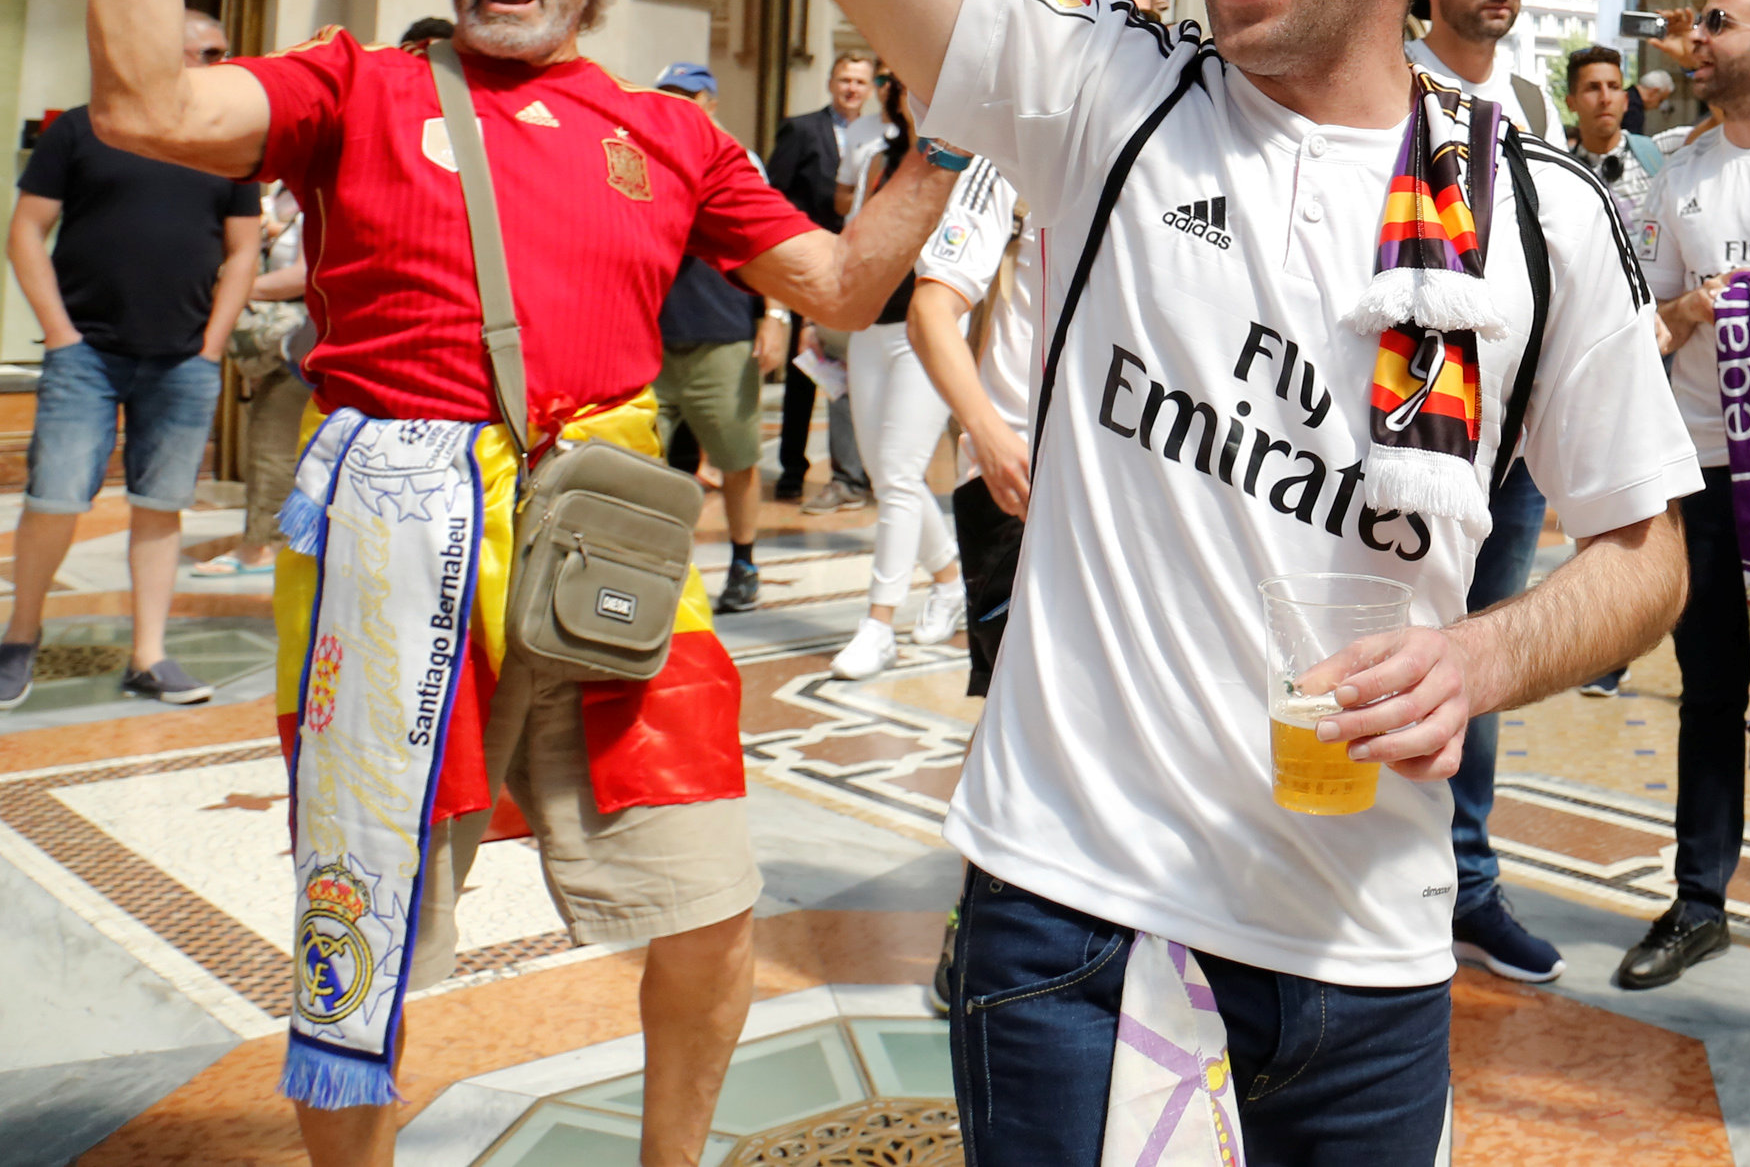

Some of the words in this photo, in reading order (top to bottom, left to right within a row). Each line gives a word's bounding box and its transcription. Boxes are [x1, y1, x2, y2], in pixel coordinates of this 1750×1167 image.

[1162, 211, 1232, 250] adidas
[1233, 321, 1332, 429] Fly
[431, 516, 468, 631] Bernabeu
[408, 635, 455, 747] Santiago
